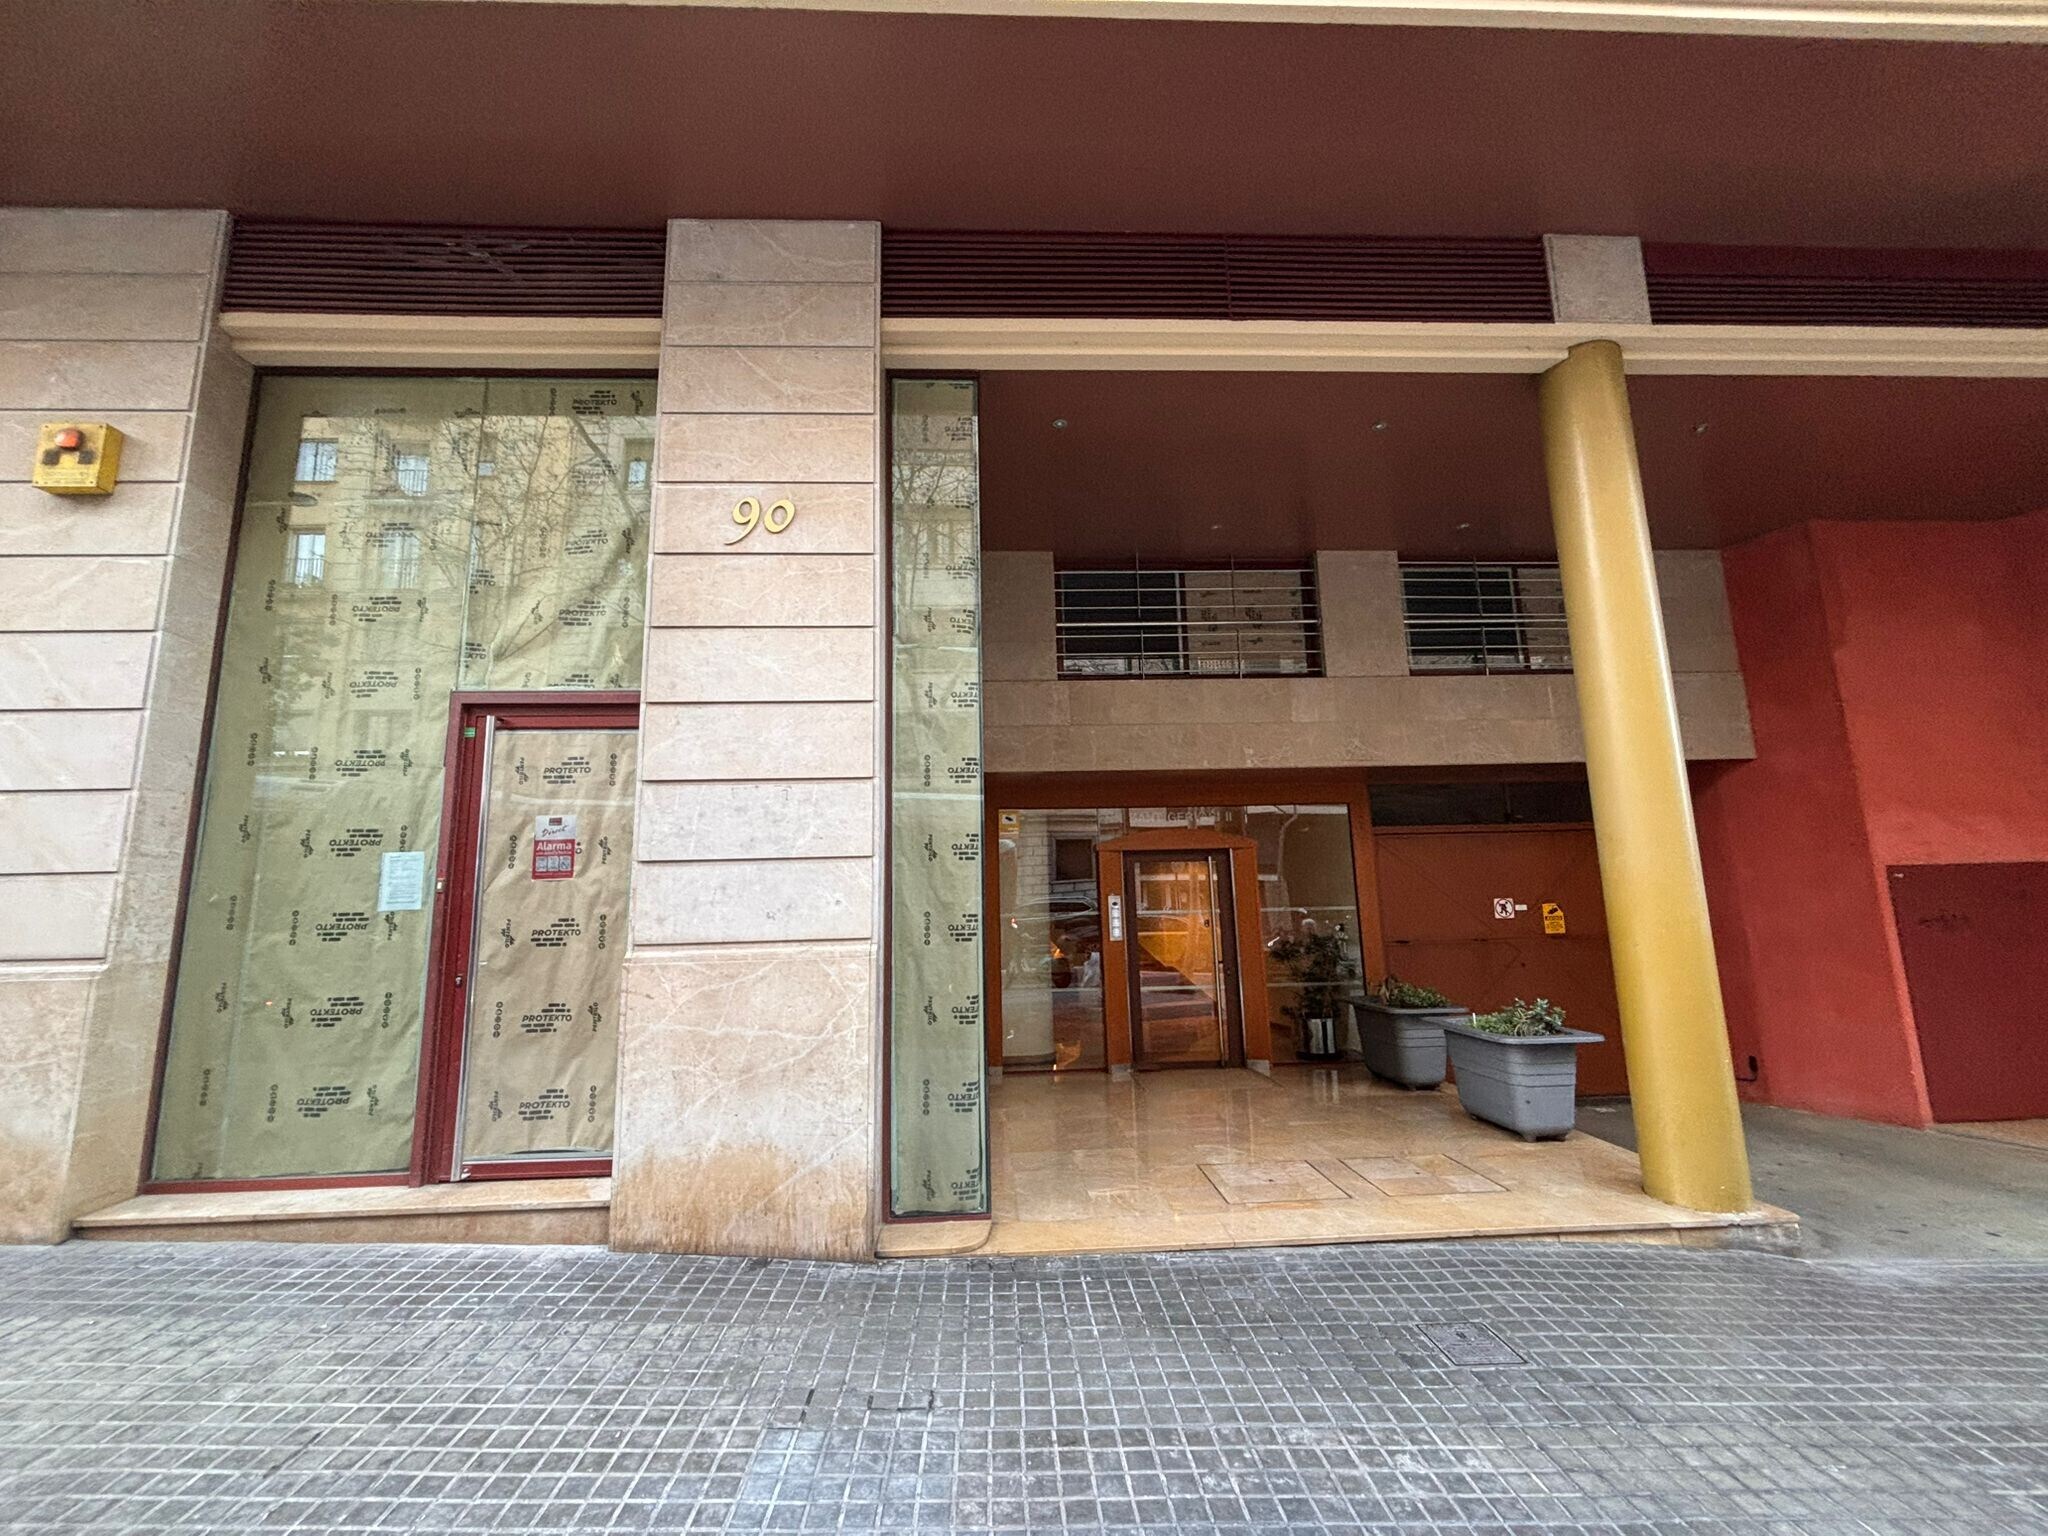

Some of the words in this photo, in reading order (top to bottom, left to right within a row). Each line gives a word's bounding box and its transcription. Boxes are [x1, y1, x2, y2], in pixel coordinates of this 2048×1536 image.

[724, 496, 796, 546] 90
[558, 608, 607, 617] PROTEKTO
[350, 680, 398, 688] PROTEKTO
[335, 759, 386, 768] PROTEKTO
[543, 766, 592, 774] PROTEKTO
[328, 838, 382, 848] PROTEKTO
[536, 842, 572, 851] Alarma
[315, 922, 368, 931] PROTEKTO
[531, 929, 582, 937] PROTEKTO
[310, 1008, 362, 1016] PROTEKTO
[521, 1014, 572, 1022] PROTEKTO
[296, 1097, 350, 1106] PROTEKTO
[518, 1100, 571, 1110] PROTEKTO
